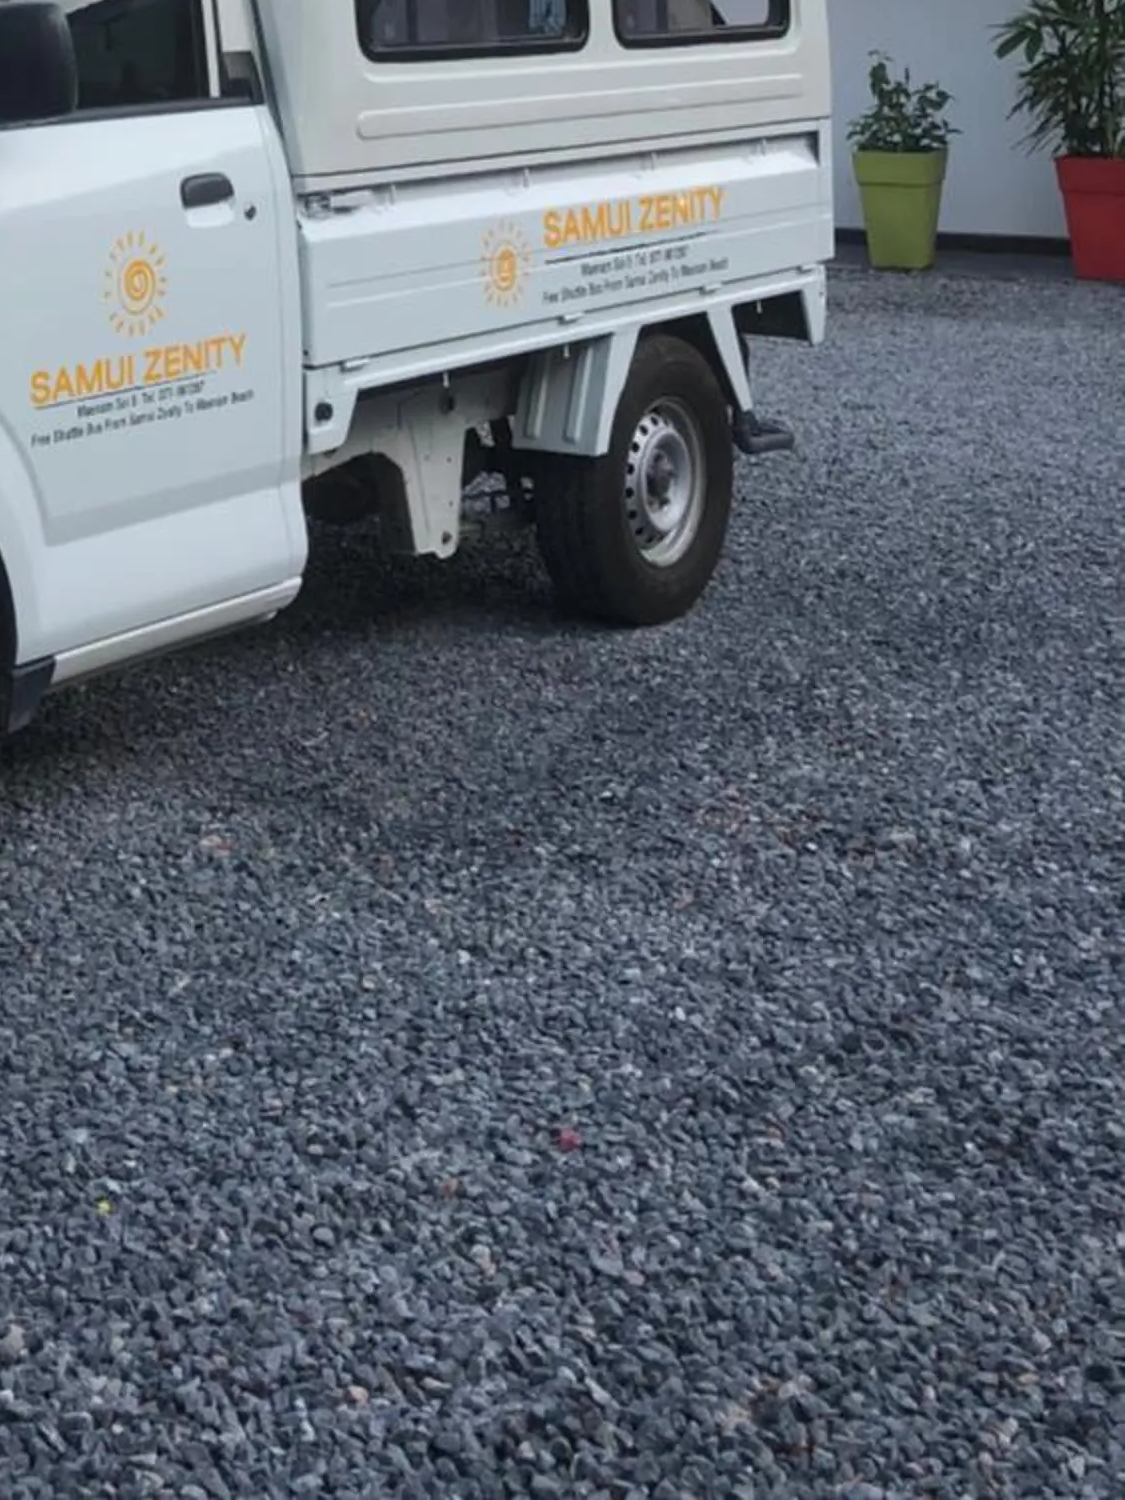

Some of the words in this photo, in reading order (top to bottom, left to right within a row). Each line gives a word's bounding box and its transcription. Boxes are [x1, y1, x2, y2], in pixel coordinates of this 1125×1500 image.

[543, 198, 632, 248] SAMUI
[639, 186, 724, 230] ZENITY
[30, 355, 134, 404] SAMUI
[143, 334, 246, 383] ZENITY
